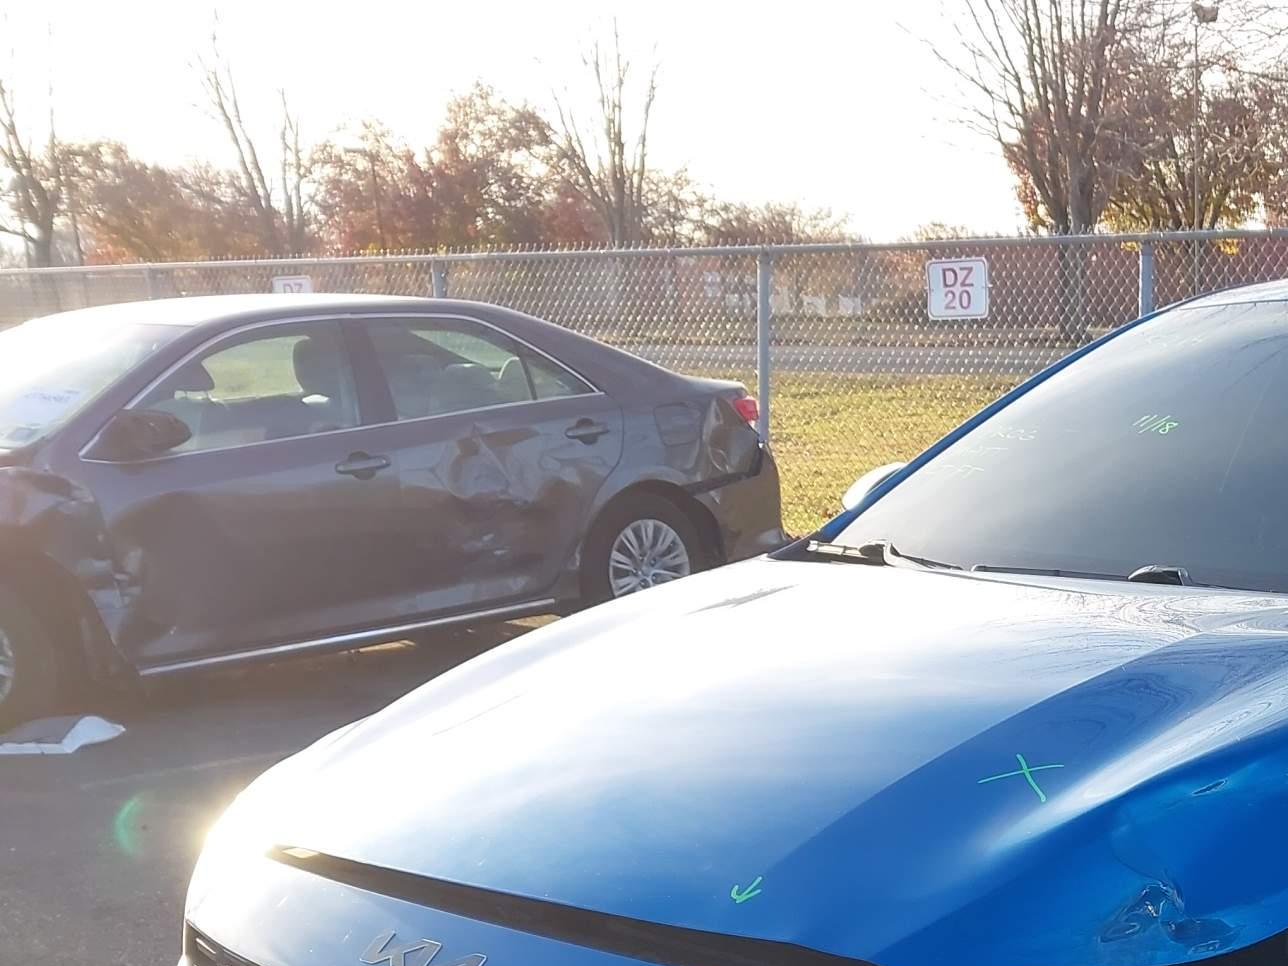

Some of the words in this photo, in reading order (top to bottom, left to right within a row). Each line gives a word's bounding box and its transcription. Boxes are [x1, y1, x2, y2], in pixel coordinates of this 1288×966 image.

[941, 266, 975, 288] DZ
[944, 289, 972, 310] 20
[1131, 414, 1179, 434] 11/18
